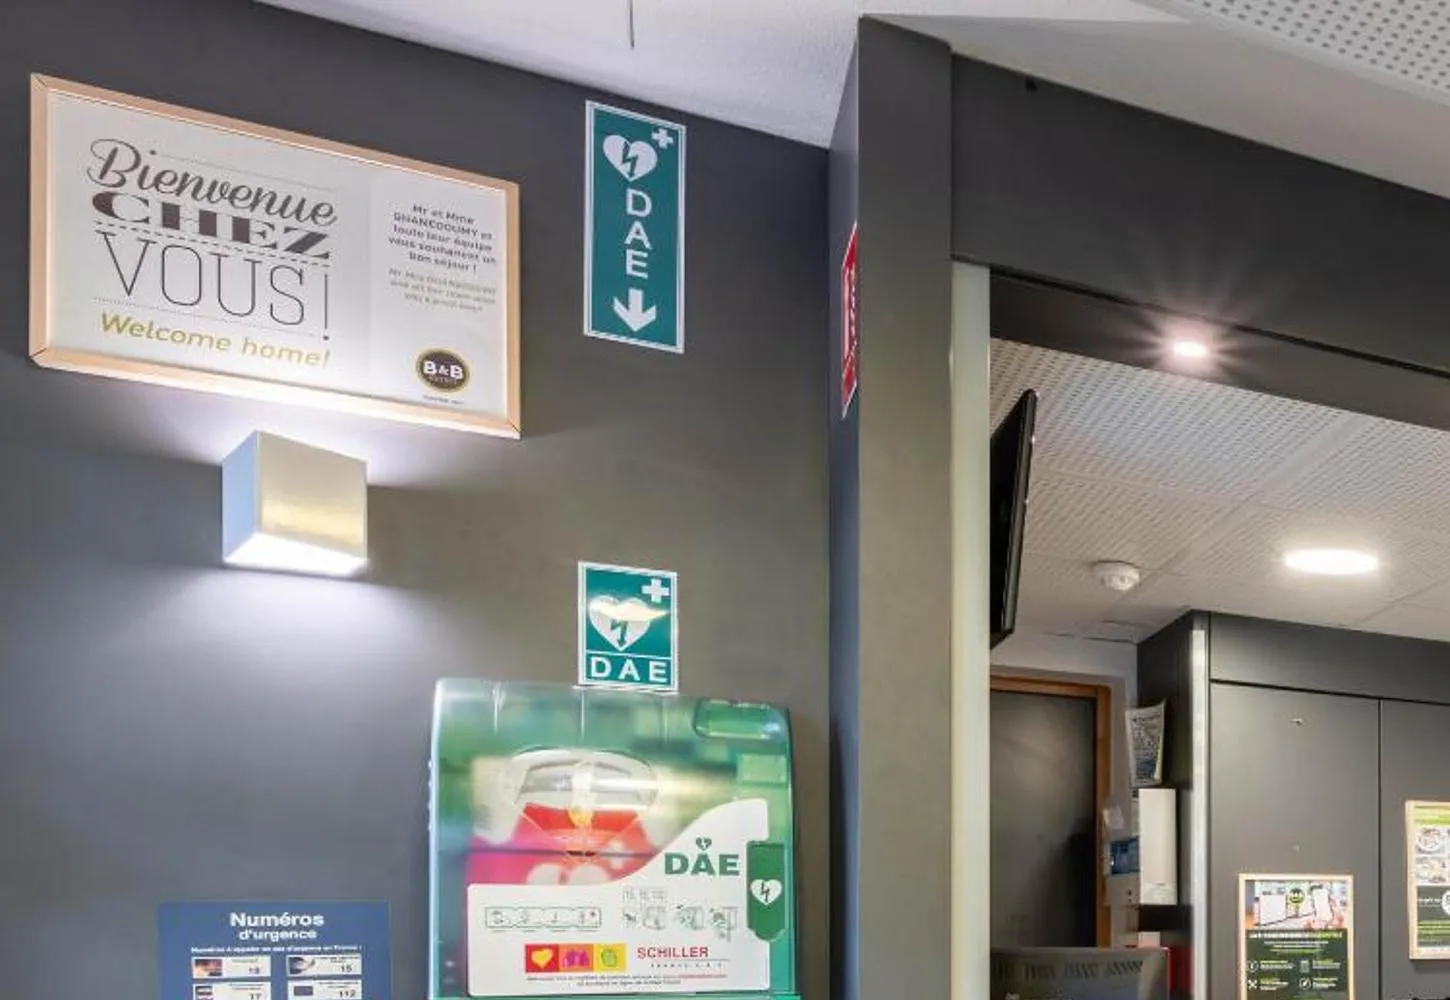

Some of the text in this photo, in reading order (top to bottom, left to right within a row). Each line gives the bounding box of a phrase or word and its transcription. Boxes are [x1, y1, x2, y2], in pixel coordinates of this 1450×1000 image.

[87, 138, 338, 227] Bienvenue
[92, 191, 330, 260] CHEZ
[623, 188, 652, 279] DAE
[101, 312, 331, 368] Welcome home!
[423, 360, 464, 380] B&B
[590, 656, 668, 683] DAE
[664, 852, 740, 877] DAE
[229, 911, 325, 927] Numéros
[238, 928, 318, 942] d'urgence
[637, 946, 709, 959] SCHILLER
